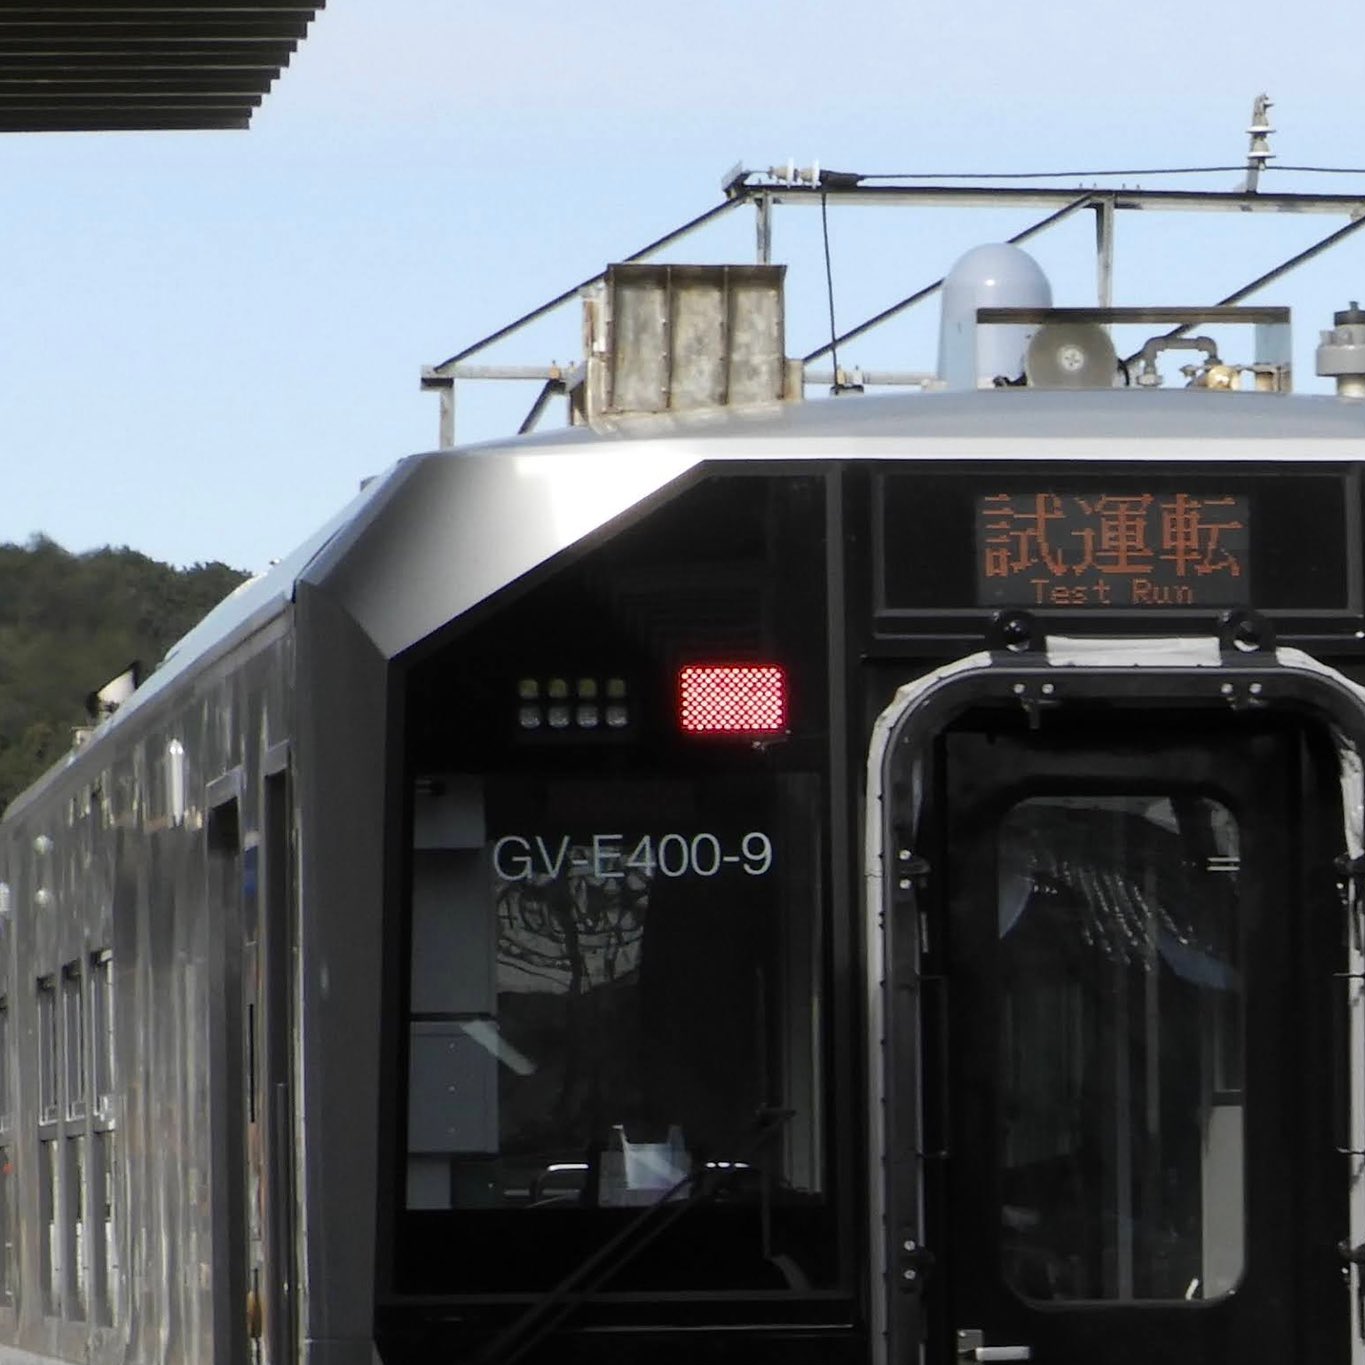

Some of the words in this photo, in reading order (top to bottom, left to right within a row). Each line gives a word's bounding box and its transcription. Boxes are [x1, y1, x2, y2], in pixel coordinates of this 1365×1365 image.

[982, 493, 1243, 576] 試運転
[1031, 578, 1110, 604] Test
[1132, 578, 1193, 604] Run
[493, 832, 773, 880] GV-E400-9
